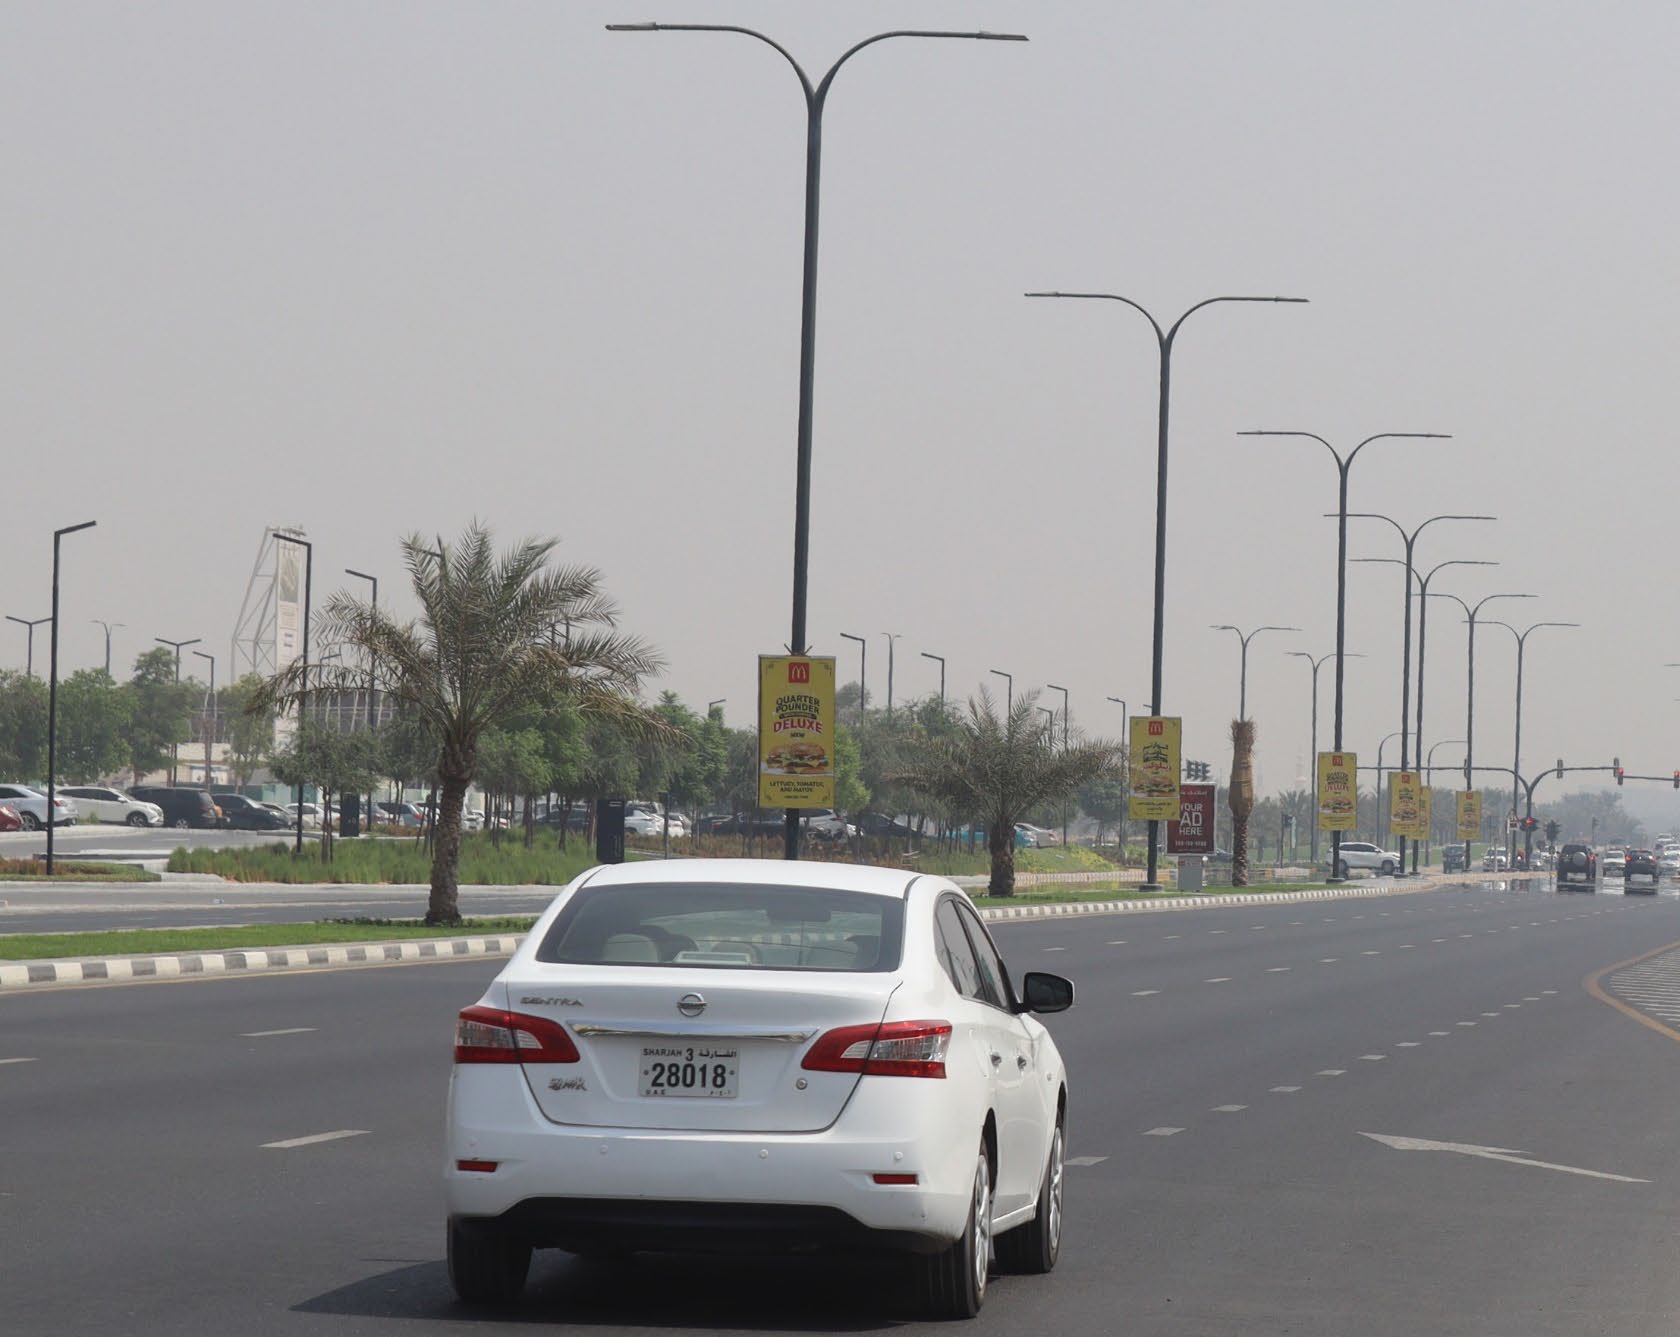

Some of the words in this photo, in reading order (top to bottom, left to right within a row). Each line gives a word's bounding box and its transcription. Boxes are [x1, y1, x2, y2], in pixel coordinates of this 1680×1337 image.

[776, 695, 820, 706] QUARTER
[776, 703, 820, 714] POUNDER
[774, 718, 823, 733] DELUXE
[1180, 811, 1202, 827] AD
[1179, 827, 1203, 836] HERE
[643, 1048, 682, 1057] SHARJAH
[685, 1047, 694, 1062] 3
[651, 1062, 726, 1088] 28018
